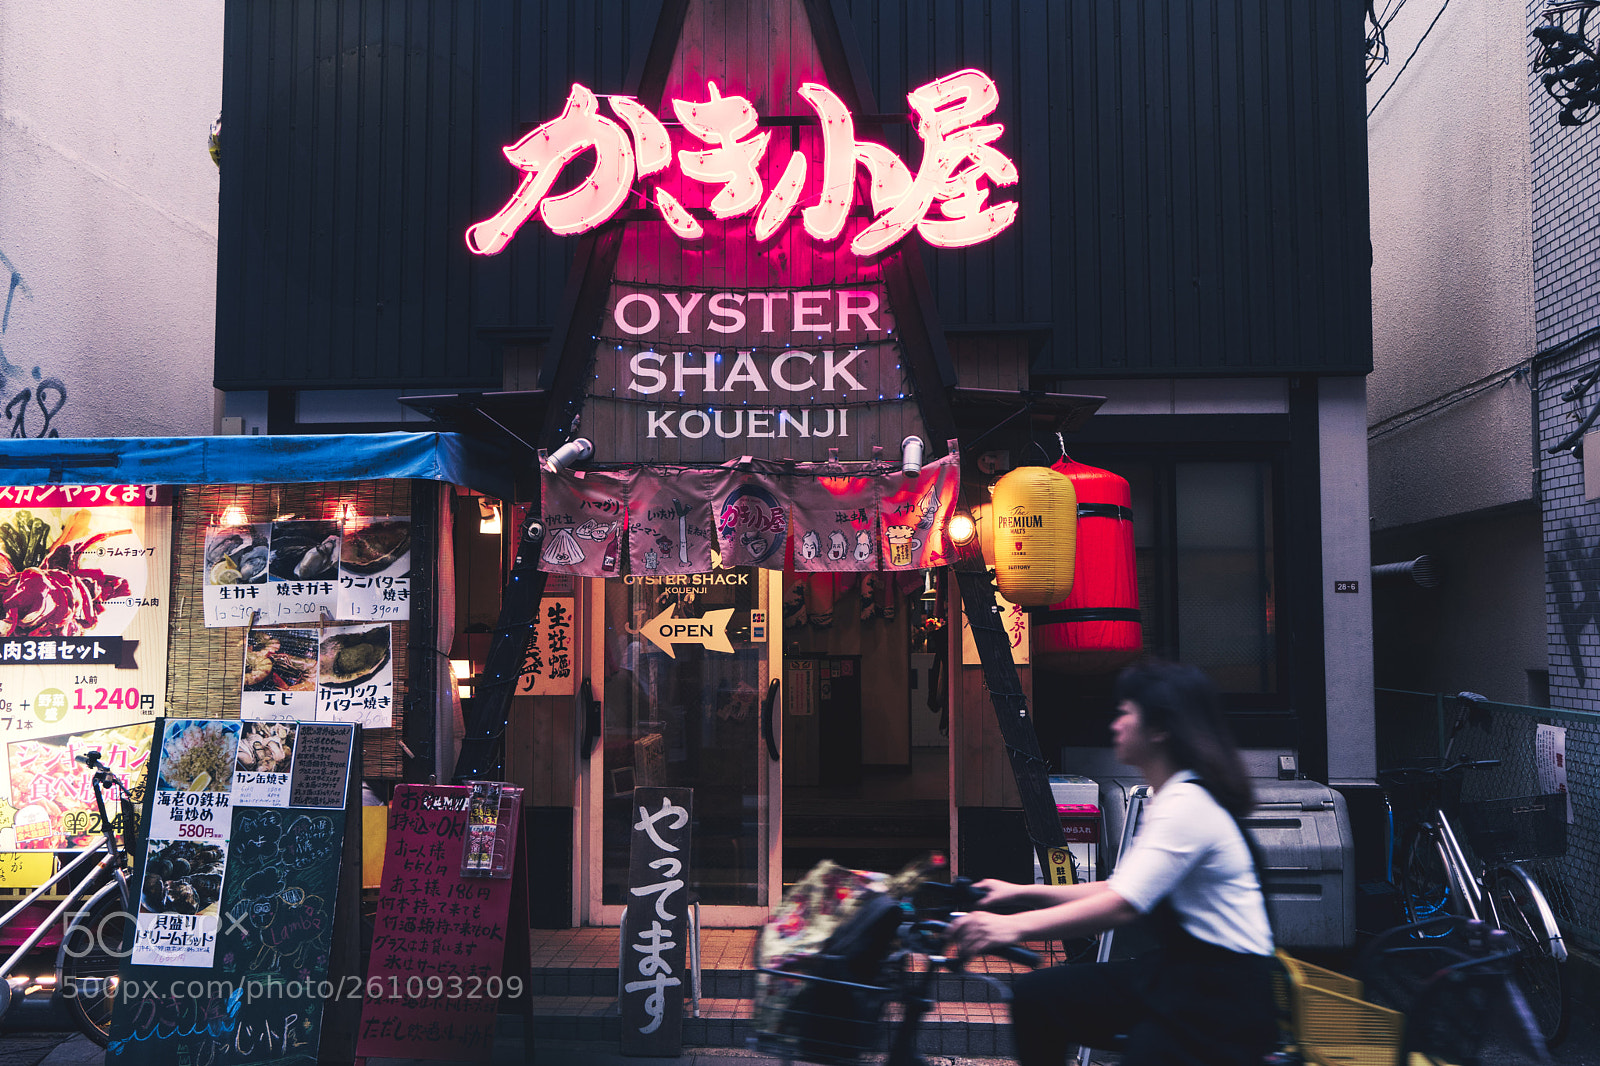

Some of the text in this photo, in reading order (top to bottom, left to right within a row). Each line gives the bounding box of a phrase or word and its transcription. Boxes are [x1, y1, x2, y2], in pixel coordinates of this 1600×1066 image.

[464, 68, 1020, 257] かき小屋
[614, 290, 881, 335] OYSTER
[627, 350, 867, 394] SHACK
[646, 408, 850, 439] KOUENJI
[580, 499, 620, 515] ハマグリ
[894, 502, 915, 516] イカ
[545, 513, 576, 525] 帆立
[647, 508, 676, 521] しいたけ
[718, 504, 786, 535] かき小屋
[999, 515, 1043, 528] PREMIUM
[630, 523, 661, 537] ピーマン
[340, 576, 407, 589] ウニバター
[623, 573, 749, 585] OYSTER SHACK
[219, 586, 260, 600] 生カキ
[276, 582, 333, 596] 焼きガキ
[664, 586, 707, 594] KOUENJI
[1337, 583, 1356, 591] 28-6
[382, 588, 411, 601] 焼き
[659, 624, 713, 637] OPEN
[0, 640, 106, 661] 肉3種セット
[263, 692, 294, 706] エビ
[325, 696, 391, 712] バター焼き
[236, 772, 289, 785] カン缶焼き
[157, 791, 230, 807] 海老の鉄板
[170, 807, 214, 822] 塩炒め
[178, 824, 214, 838] 580円
[624, 796, 691, 1034] やってます
[154, 914, 197, 931] 貝盛り
[271, 915, 311, 945] Lamb
[135, 929, 214, 947] ドリームセット
